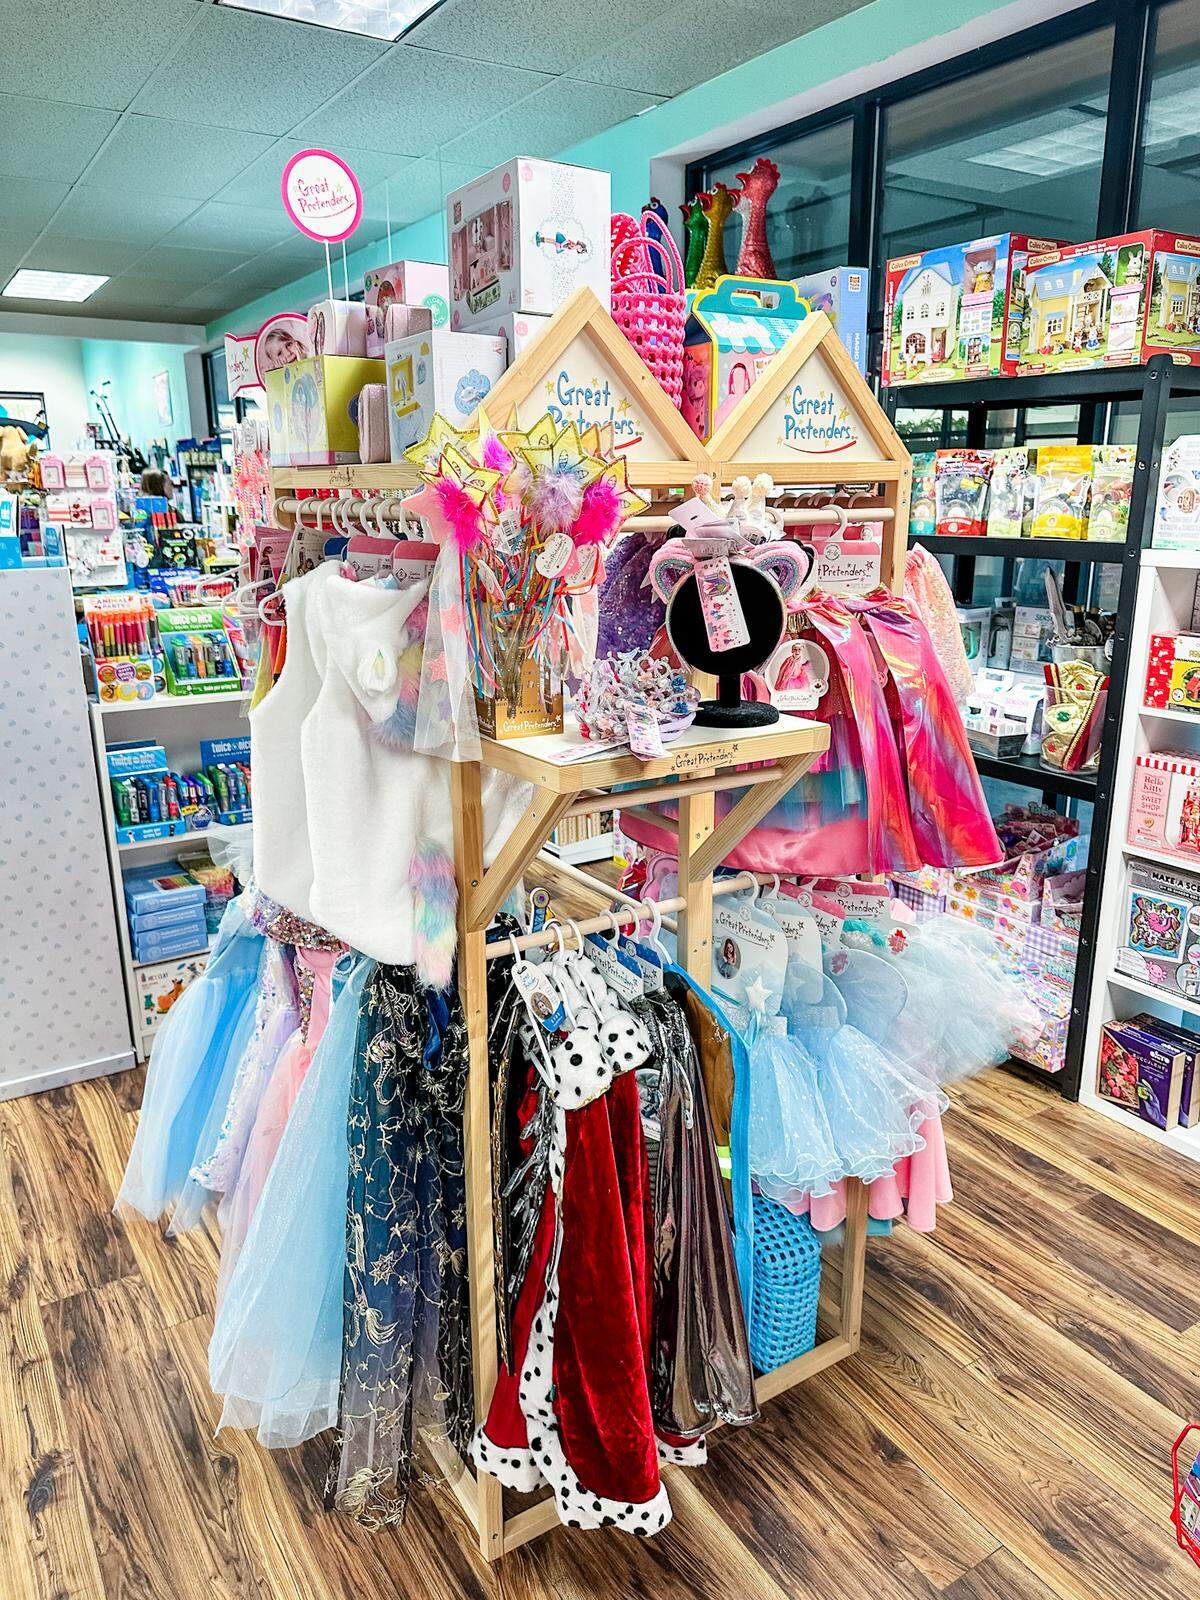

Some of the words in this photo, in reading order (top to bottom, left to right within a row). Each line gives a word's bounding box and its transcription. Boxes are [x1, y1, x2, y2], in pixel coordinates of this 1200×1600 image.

[297, 177, 329, 197] Great
[297, 190, 350, 213] Pretenders
[890, 261, 904, 270] Calico
[1029, 256, 1042, 265] Calico
[557, 370, 611, 406] Great
[792, 385, 834, 415] Great
[783, 414, 851, 439] Pretenders
[822, 564, 866, 577] Pretenders
[503, 720, 522, 732] Great
[524, 718, 557, 730] Pretenders
[675, 754, 697, 768] Great
[698, 748, 733, 763] Pretenders
[1144, 775, 1164, 786] Hello
[1140, 802, 1160, 811] SHOP
[1152, 871, 1176, 885] MAKE
[719, 911, 738, 931] Great
[738, 921, 770, 946] Pretenders
